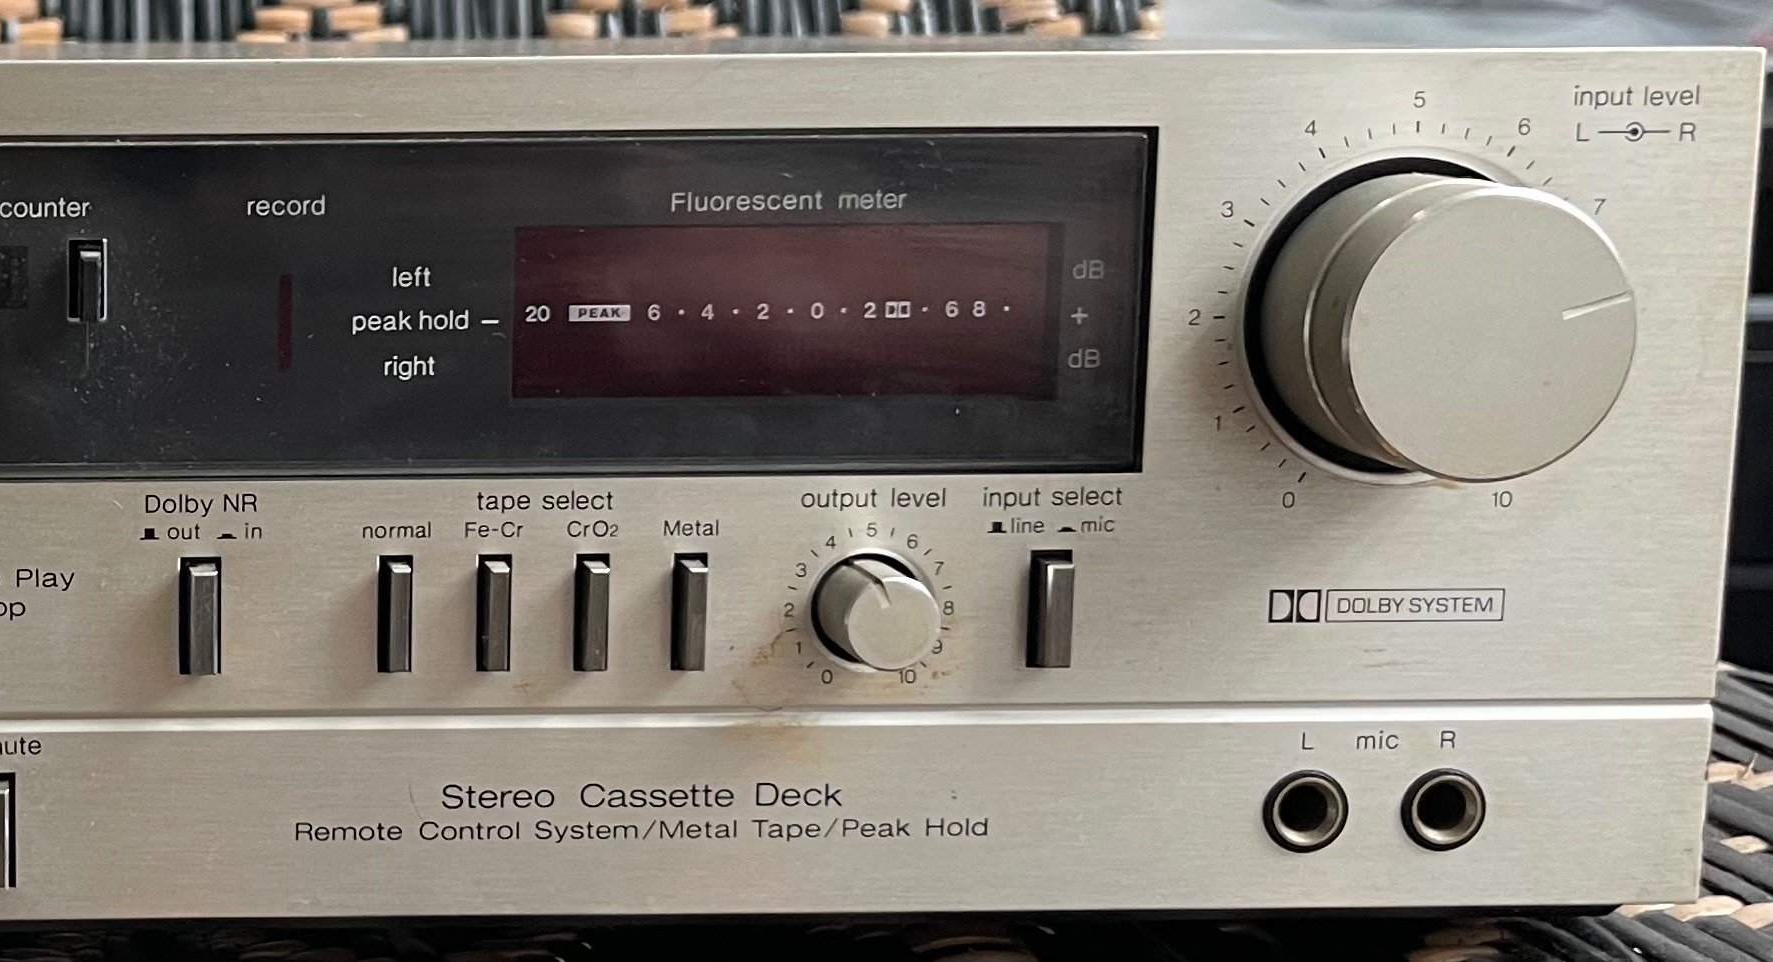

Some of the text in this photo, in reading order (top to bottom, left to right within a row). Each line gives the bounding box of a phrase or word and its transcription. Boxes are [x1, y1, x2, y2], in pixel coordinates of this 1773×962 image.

[1414, 91, 1426, 108] 5
[1573, 84, 1700, 110] input level
[1304, 120, 1317, 136] 4
[1517, 117, 1531, 136] 6
[1576, 122, 1697, 142] L R
[246, 195, 326, 216] record
[671, 191, 907, 212] Fluorescent meter
[1221, 201, 1234, 218] 3
[1594, 198, 1606, 213] 7
[392, 267, 431, 287] left
[1072, 259, 1105, 280] dB
[525, 301, 986, 322] 20 PEAK 6 4 2 0 2 6 8
[1188, 310, 1201, 326] 2
[352, 310, 469, 335] peak hold
[383, 356, 435, 379] right
[1068, 349, 1101, 369] dB
[144, 493, 258, 518] Dolby NR
[477, 491, 614, 514] tape select
[801, 488, 947, 511] output level
[983, 487, 1123, 510] input select
[1282, 493, 1296, 509] 0
[1492, 492, 1513, 509] 10
[167, 524, 262, 540] out in
[362, 522, 432, 539] normal
[464, 522, 524, 538] Fe-Cr
[663, 520, 719, 537] Metal
[866, 523, 878, 537] 5
[1011, 517, 1116, 534] line mic
[825, 535, 836, 550] 4
[906, 535, 919, 549] 6
[795, 563, 808, 578] 3
[933, 562, 944, 577] 7
[16, 569, 75, 592] Play
[783, 603, 795, 617] 2
[942, 601, 955, 616] 8
[1337, 597, 1493, 613] DOLBY SYSTEM
[931, 639, 943, 654] 9
[820, 670, 833, 685] 0
[899, 670, 917, 684] 10
[1301, 731, 1457, 750] L mic R
[441, 782, 843, 809] Stereo Cassette Deck
[294, 821, 403, 841] Remote
[418, 820, 521, 841] Control
[924, 818, 989, 837] Hold
